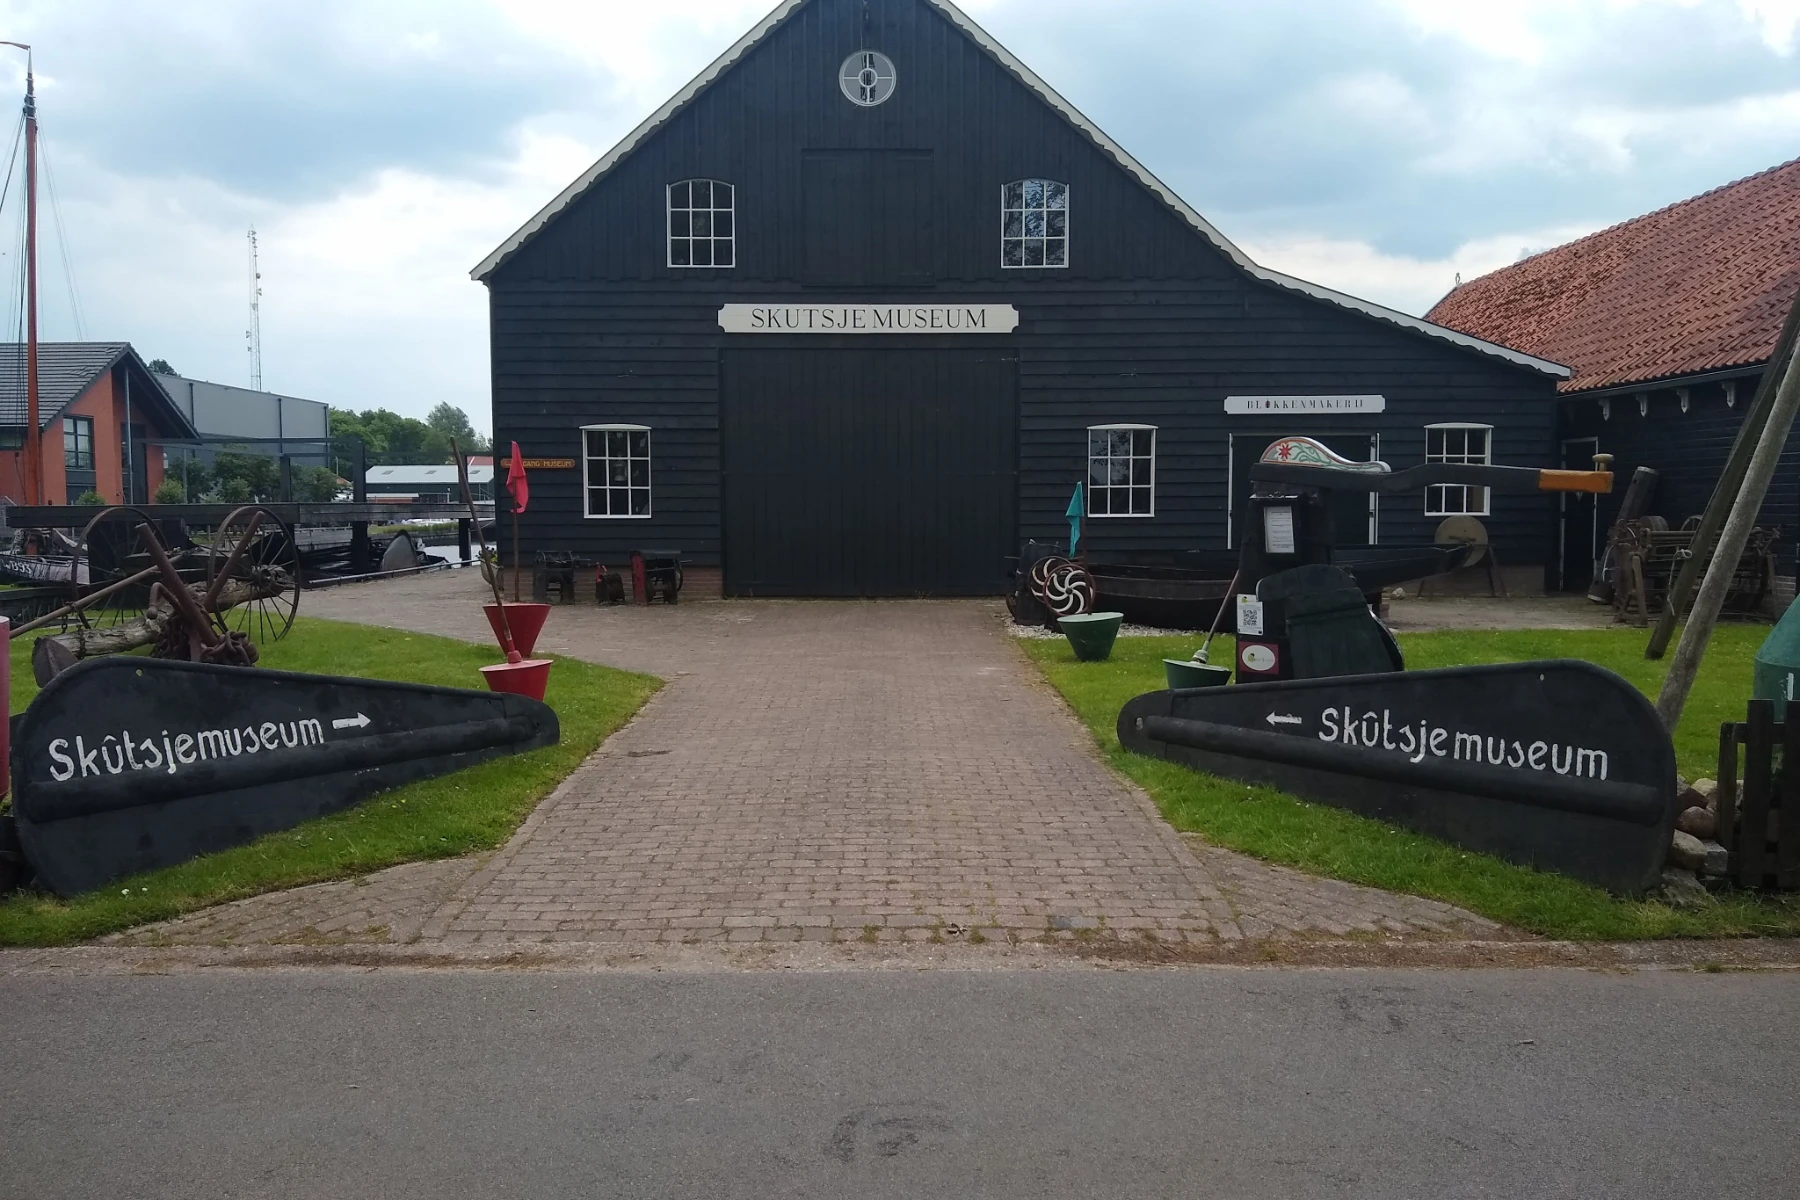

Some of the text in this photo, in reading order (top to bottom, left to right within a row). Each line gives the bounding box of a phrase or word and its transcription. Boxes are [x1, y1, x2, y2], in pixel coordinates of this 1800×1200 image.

[751, 308, 987, 328] SKUTSJEMUSEUM
[48, 718, 324, 782] Skûtsjemuseum
[1318, 706, 1609, 781] Skûtsjemuseum
